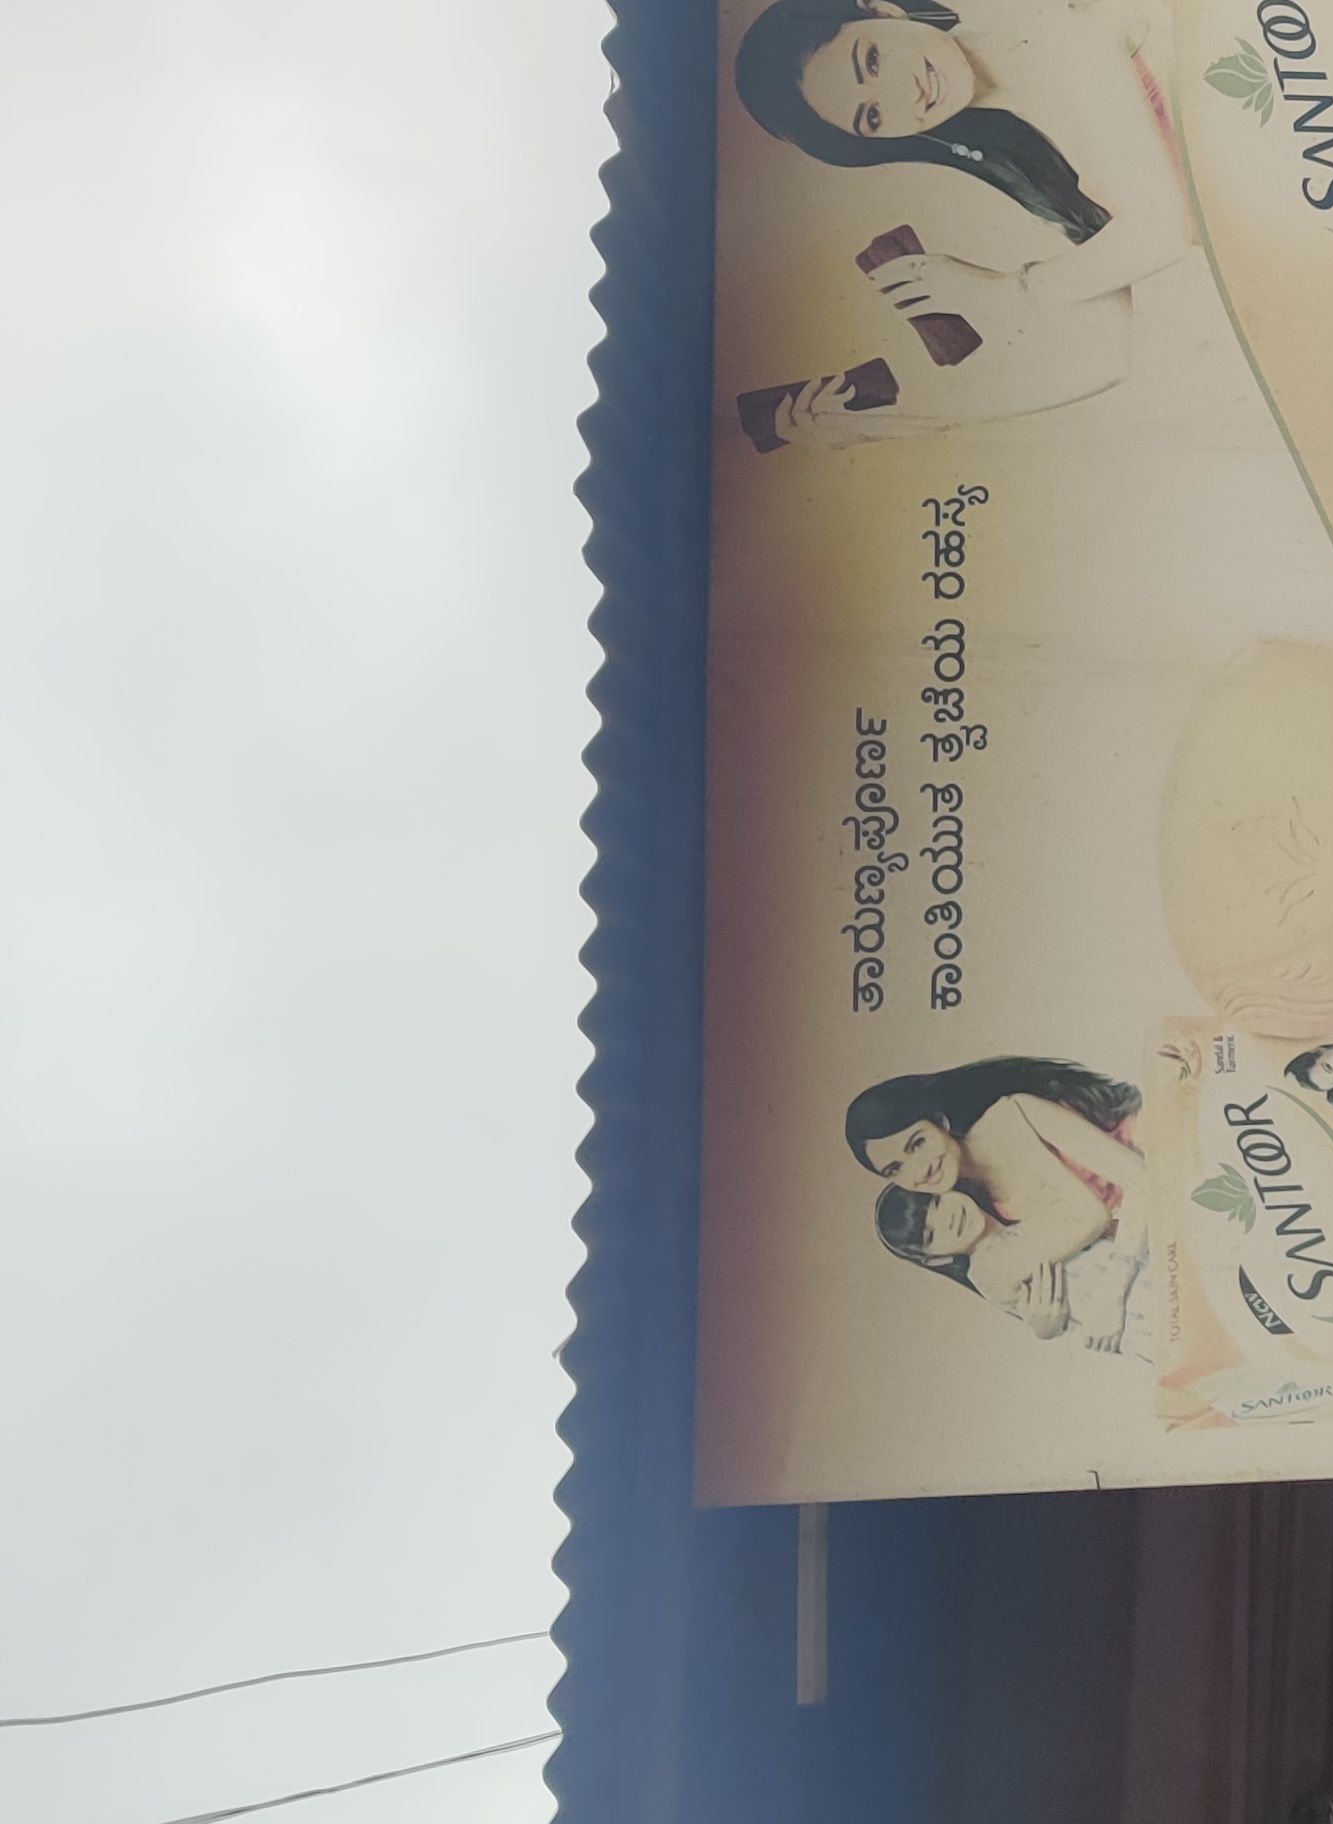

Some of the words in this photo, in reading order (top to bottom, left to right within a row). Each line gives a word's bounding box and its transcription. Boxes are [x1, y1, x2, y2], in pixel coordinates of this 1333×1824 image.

[921, 483, 990, 600] ರಹಸ್ಯ
[919, 618, 988, 763] ತ್ವಚೆಯ
[840, 706, 910, 1013] ತಾರುಣ್ಯಪೂರ್ಣ
[919, 782, 964, 1011] ಕಾಂತಿಯುತ
